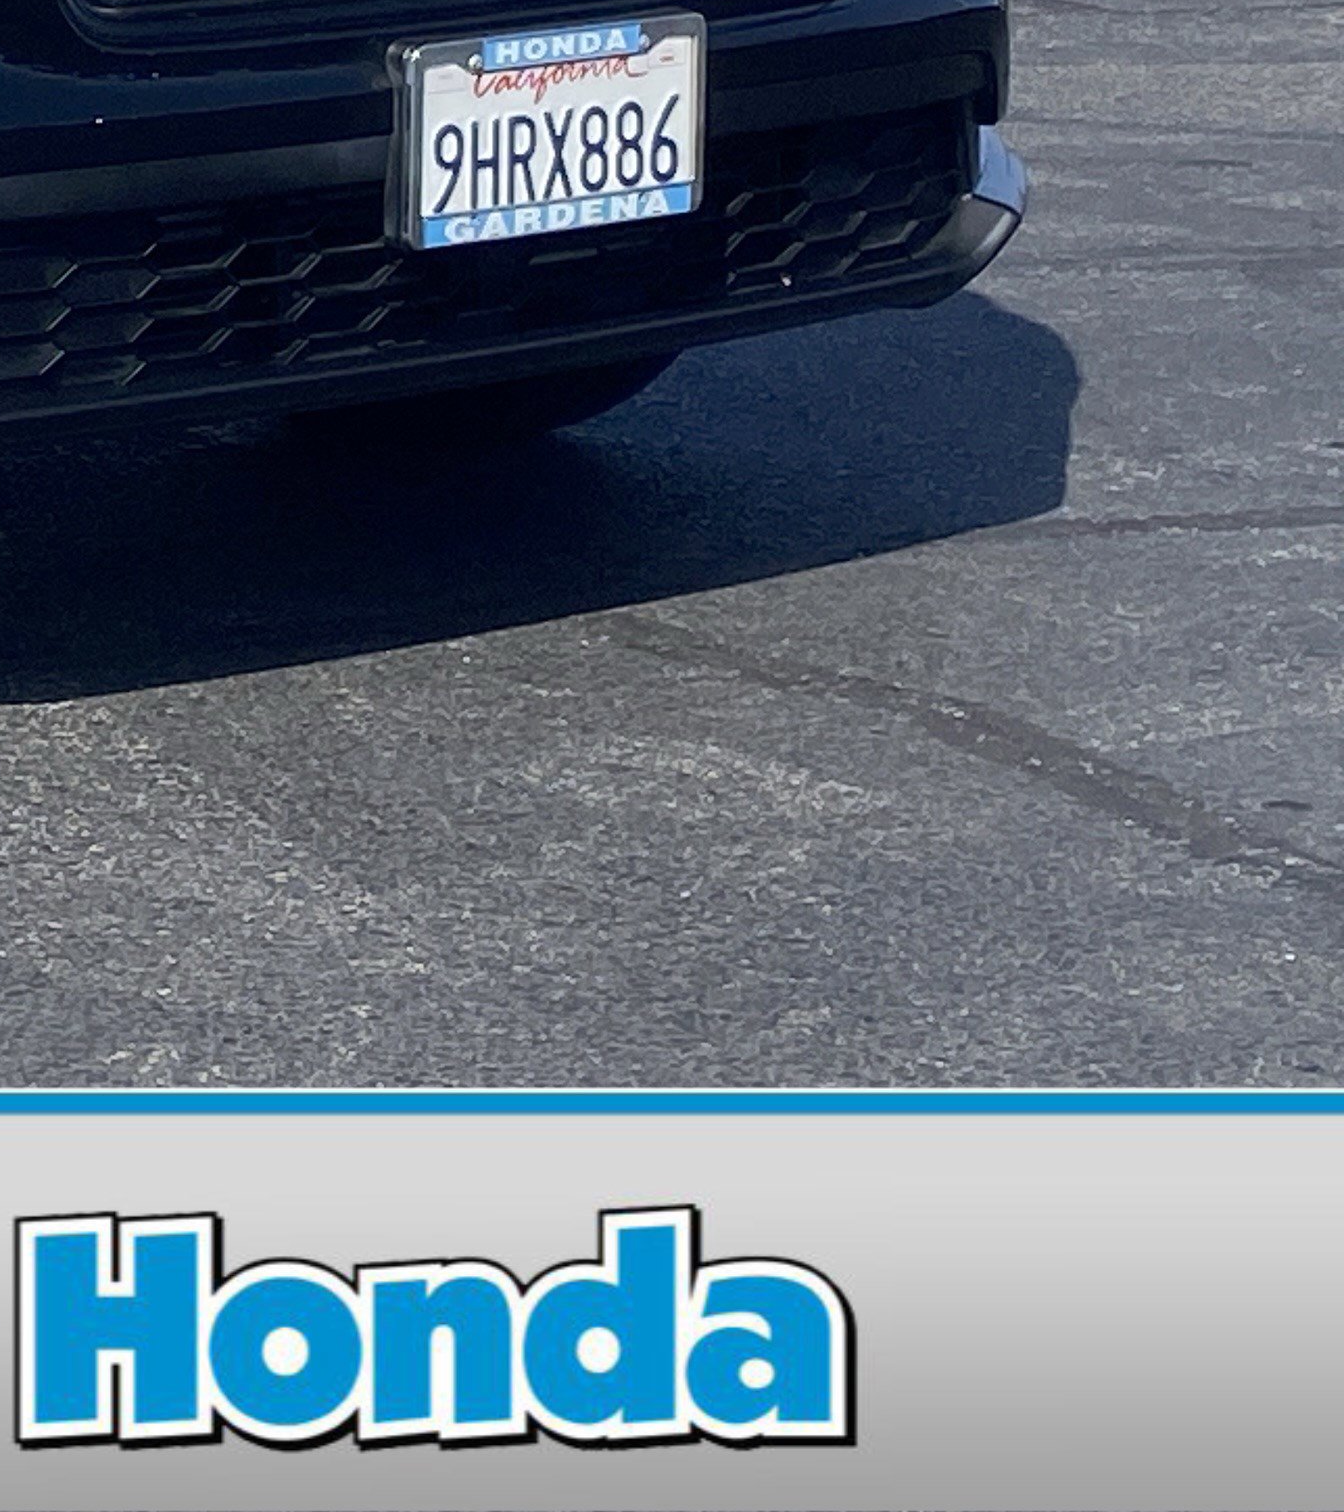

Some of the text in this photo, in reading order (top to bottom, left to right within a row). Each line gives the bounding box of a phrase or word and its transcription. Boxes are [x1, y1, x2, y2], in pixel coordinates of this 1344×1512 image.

[496, 28, 628, 64] HONDA
[433, 93, 680, 214] 9HRX886
[444, 190, 669, 243] GARDENA
